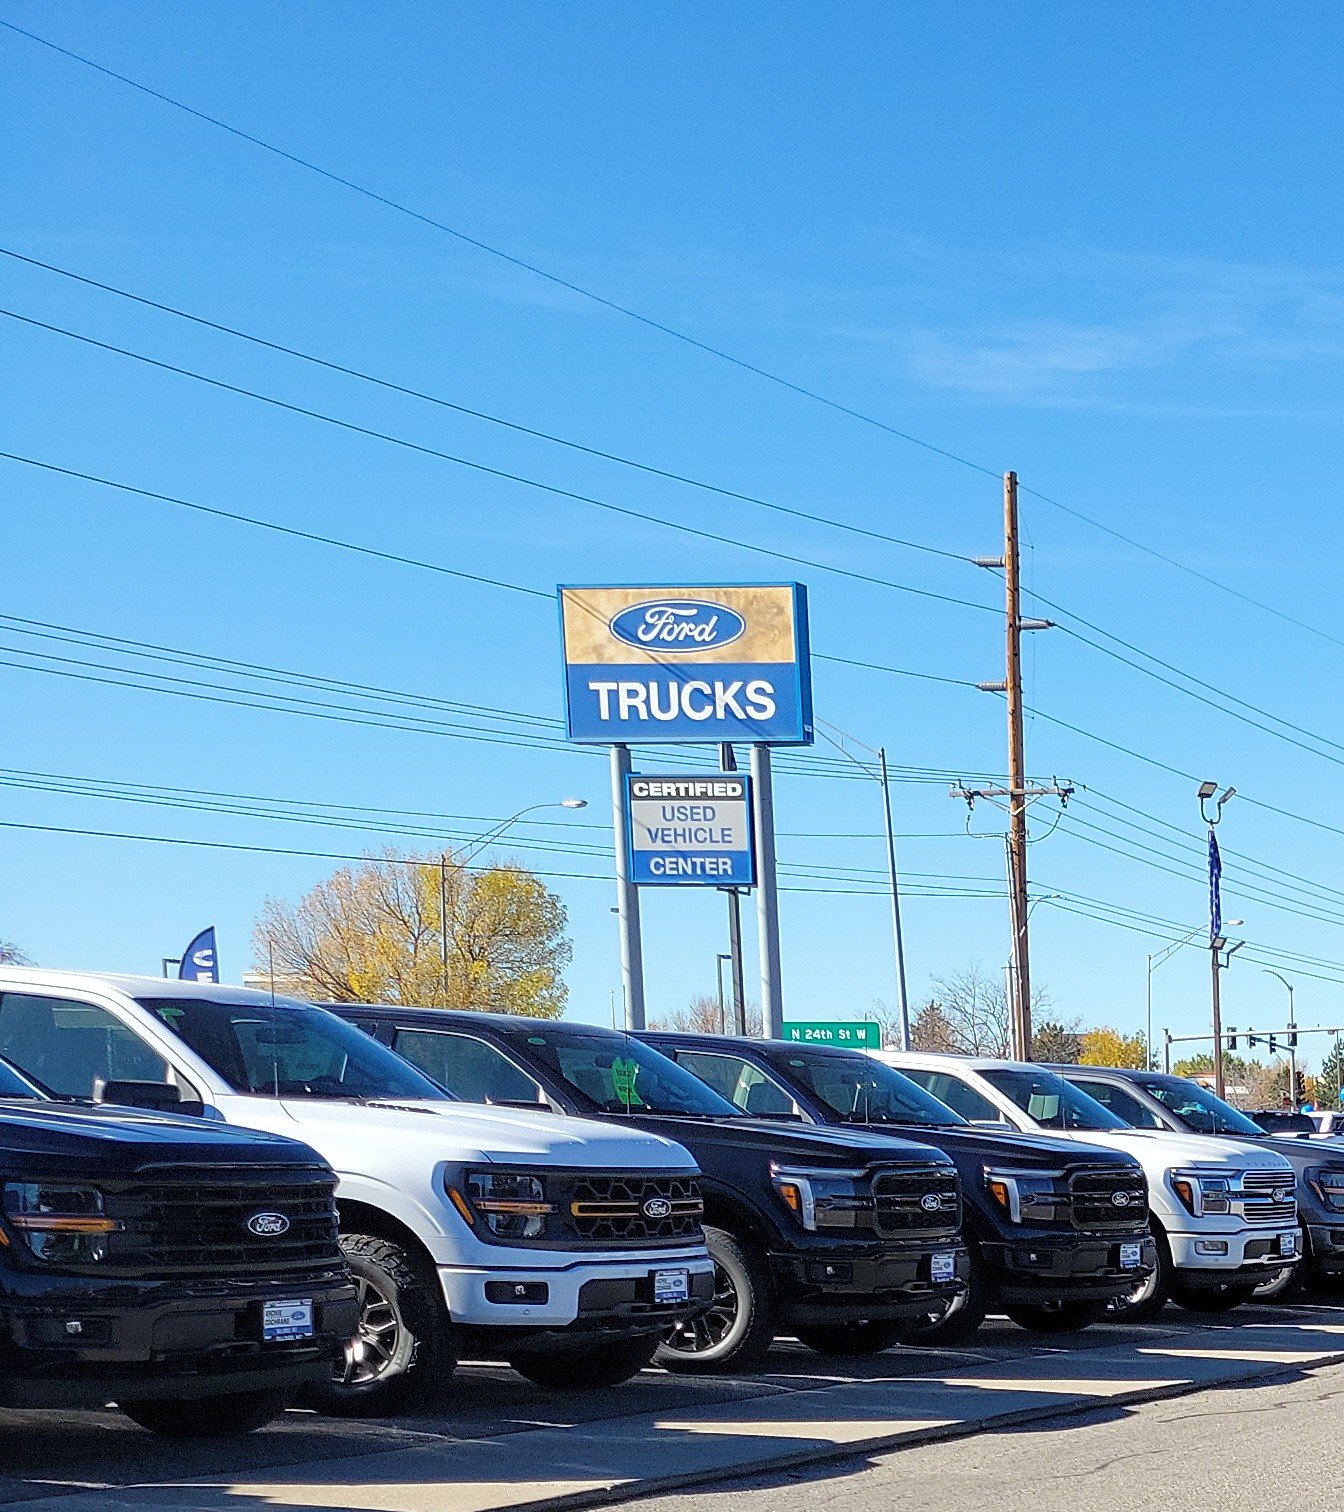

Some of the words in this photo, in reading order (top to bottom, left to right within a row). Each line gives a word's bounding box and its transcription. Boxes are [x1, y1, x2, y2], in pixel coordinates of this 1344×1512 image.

[637, 606, 719, 642] Ford
[588, 680, 776, 721] TRUCKS
[633, 782, 742, 797] CERTIFIED
[661, 805, 716, 822] USED
[646, 827, 733, 844] VEHICLE
[649, 857, 732, 875] CENTER
[791, 1028, 800, 1040] N
[804, 1028, 833, 1040] 24th
[838, 1028, 851, 1040] St
[856, 1028, 867, 1040] W
[256, 1216, 282, 1232] Ford
